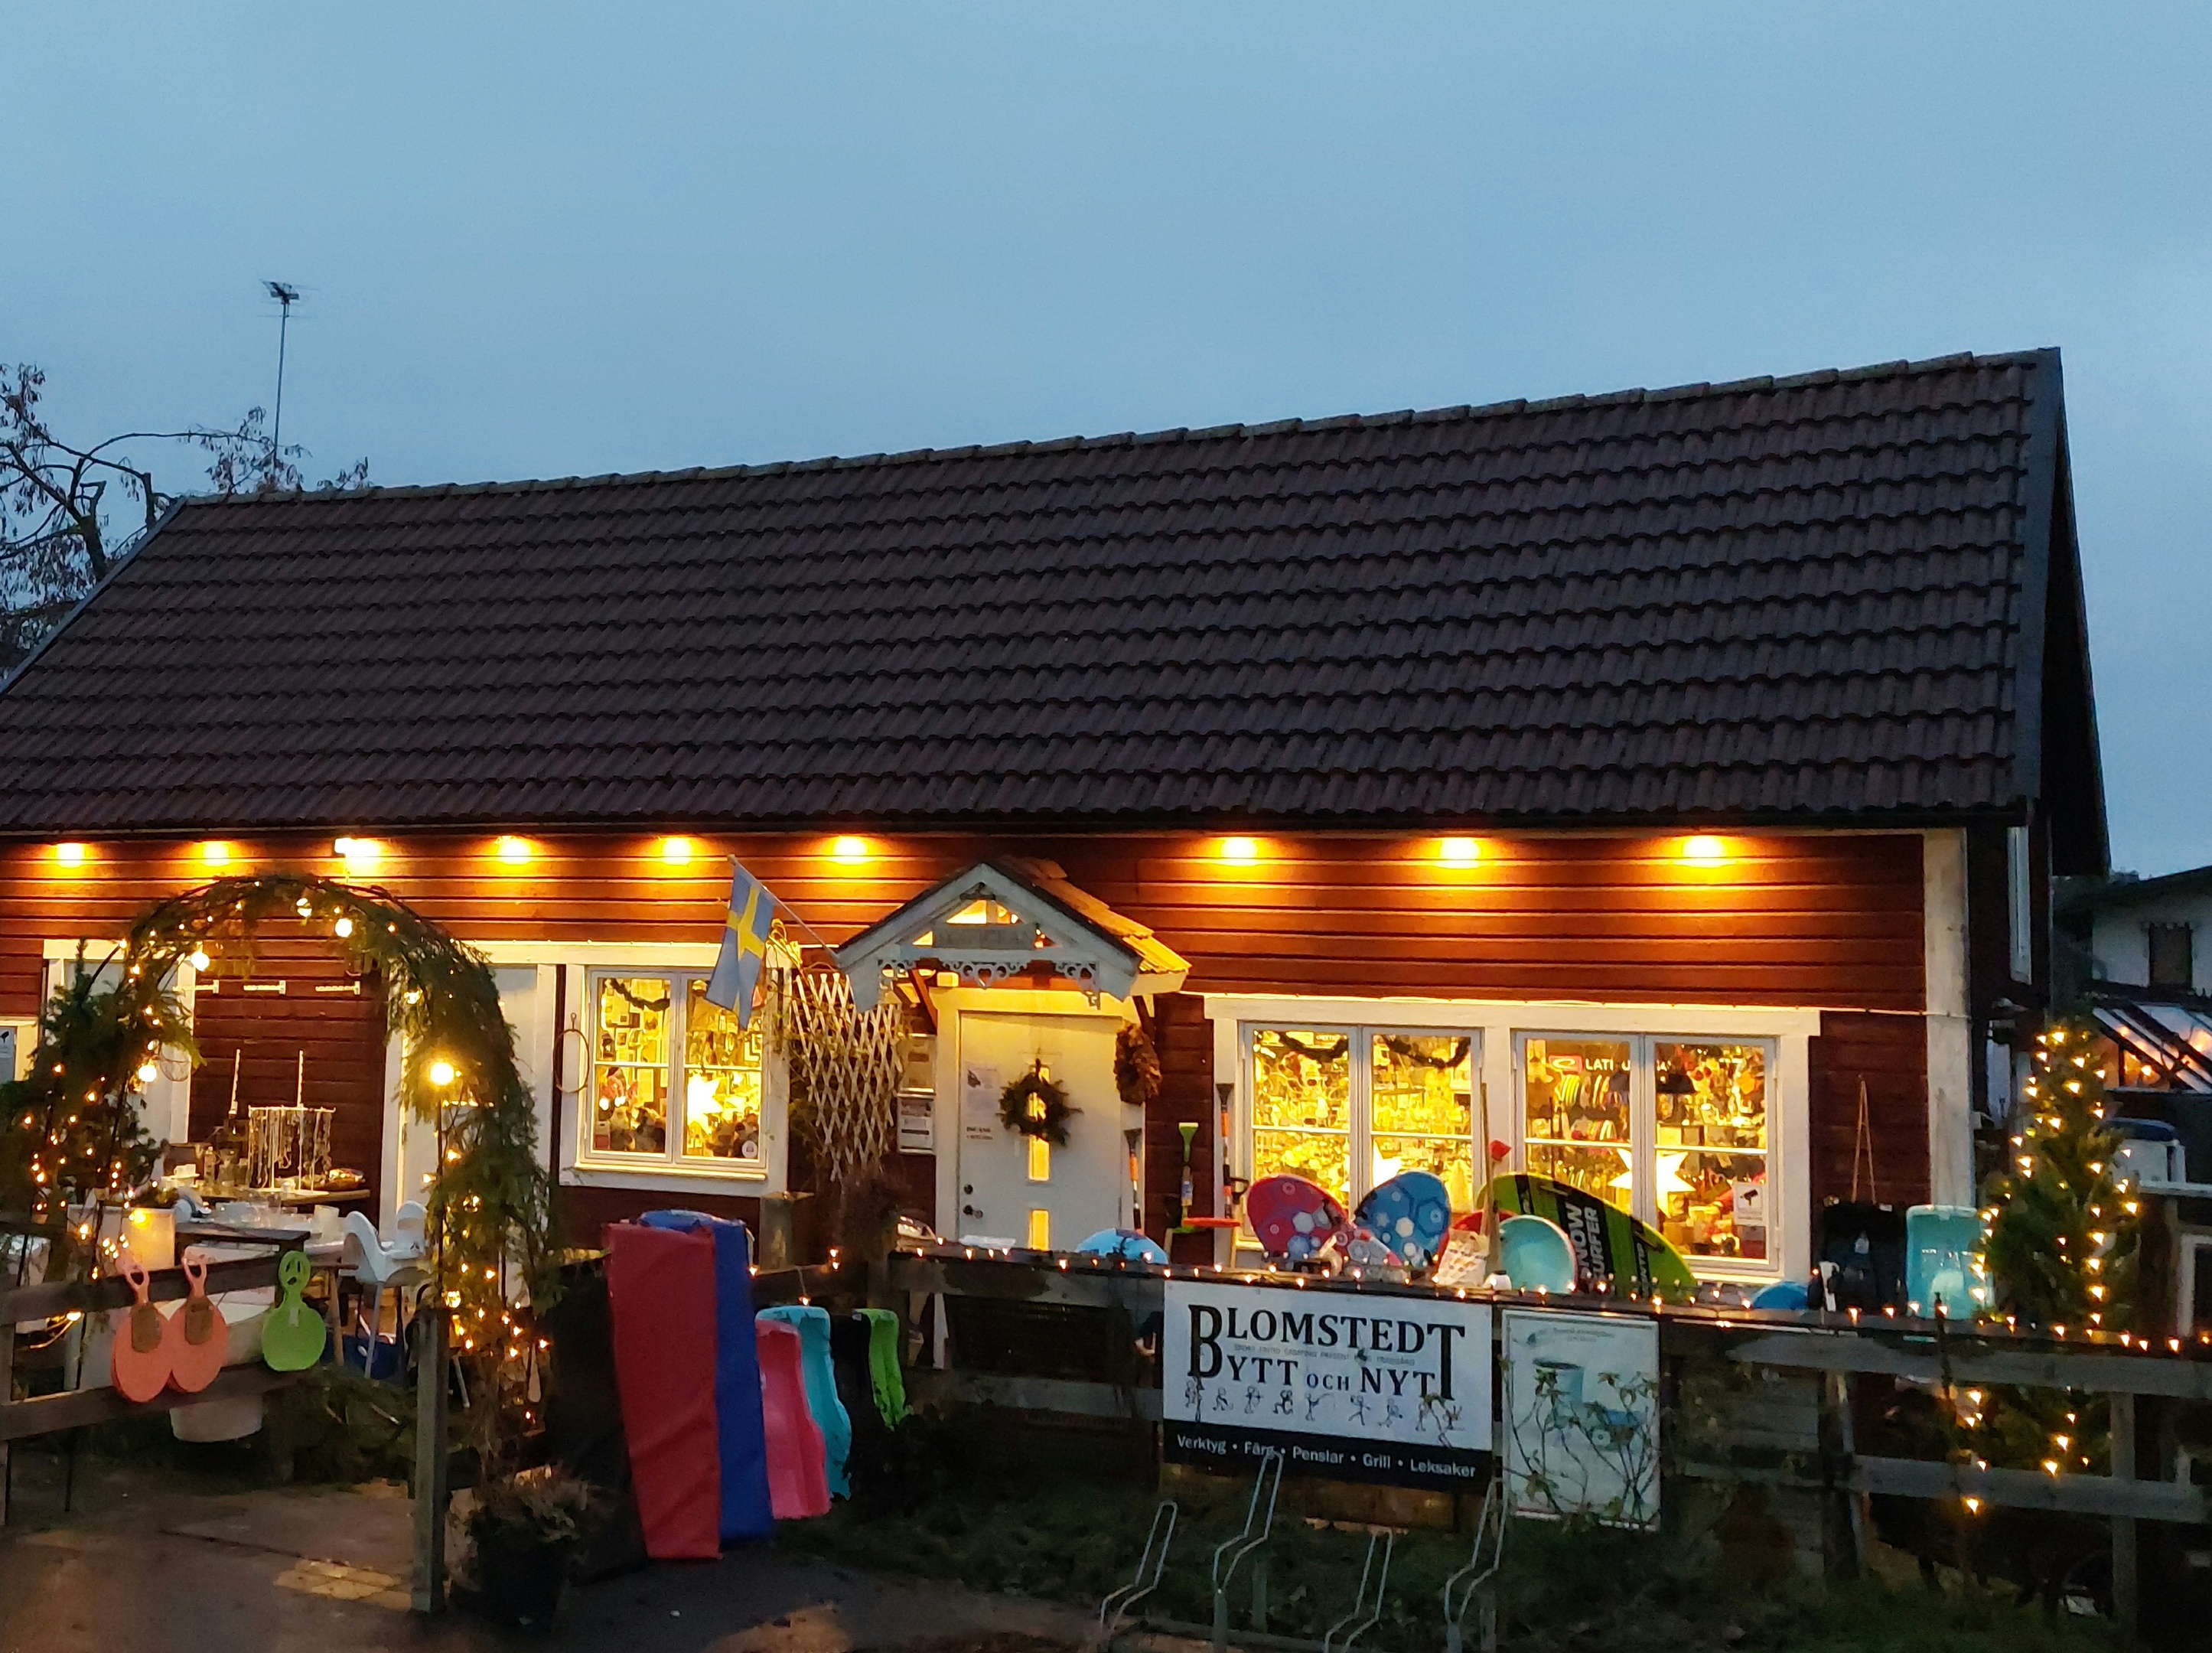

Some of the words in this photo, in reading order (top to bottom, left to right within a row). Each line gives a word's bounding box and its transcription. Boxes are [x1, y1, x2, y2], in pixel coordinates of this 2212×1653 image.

[1565, 1201, 1592, 1280] SNOW
[1187, 1304, 1464, 1400] BLOMSTEDT
[1306, 1373, 1349, 1391] OCH
[1177, 1434, 1227, 1455] Verktyg
[1292, 1446, 1344, 1465] Penslar
[1363, 1453, 1391, 1469] Grill
[1410, 1458, 1477, 1478] Leksaker
